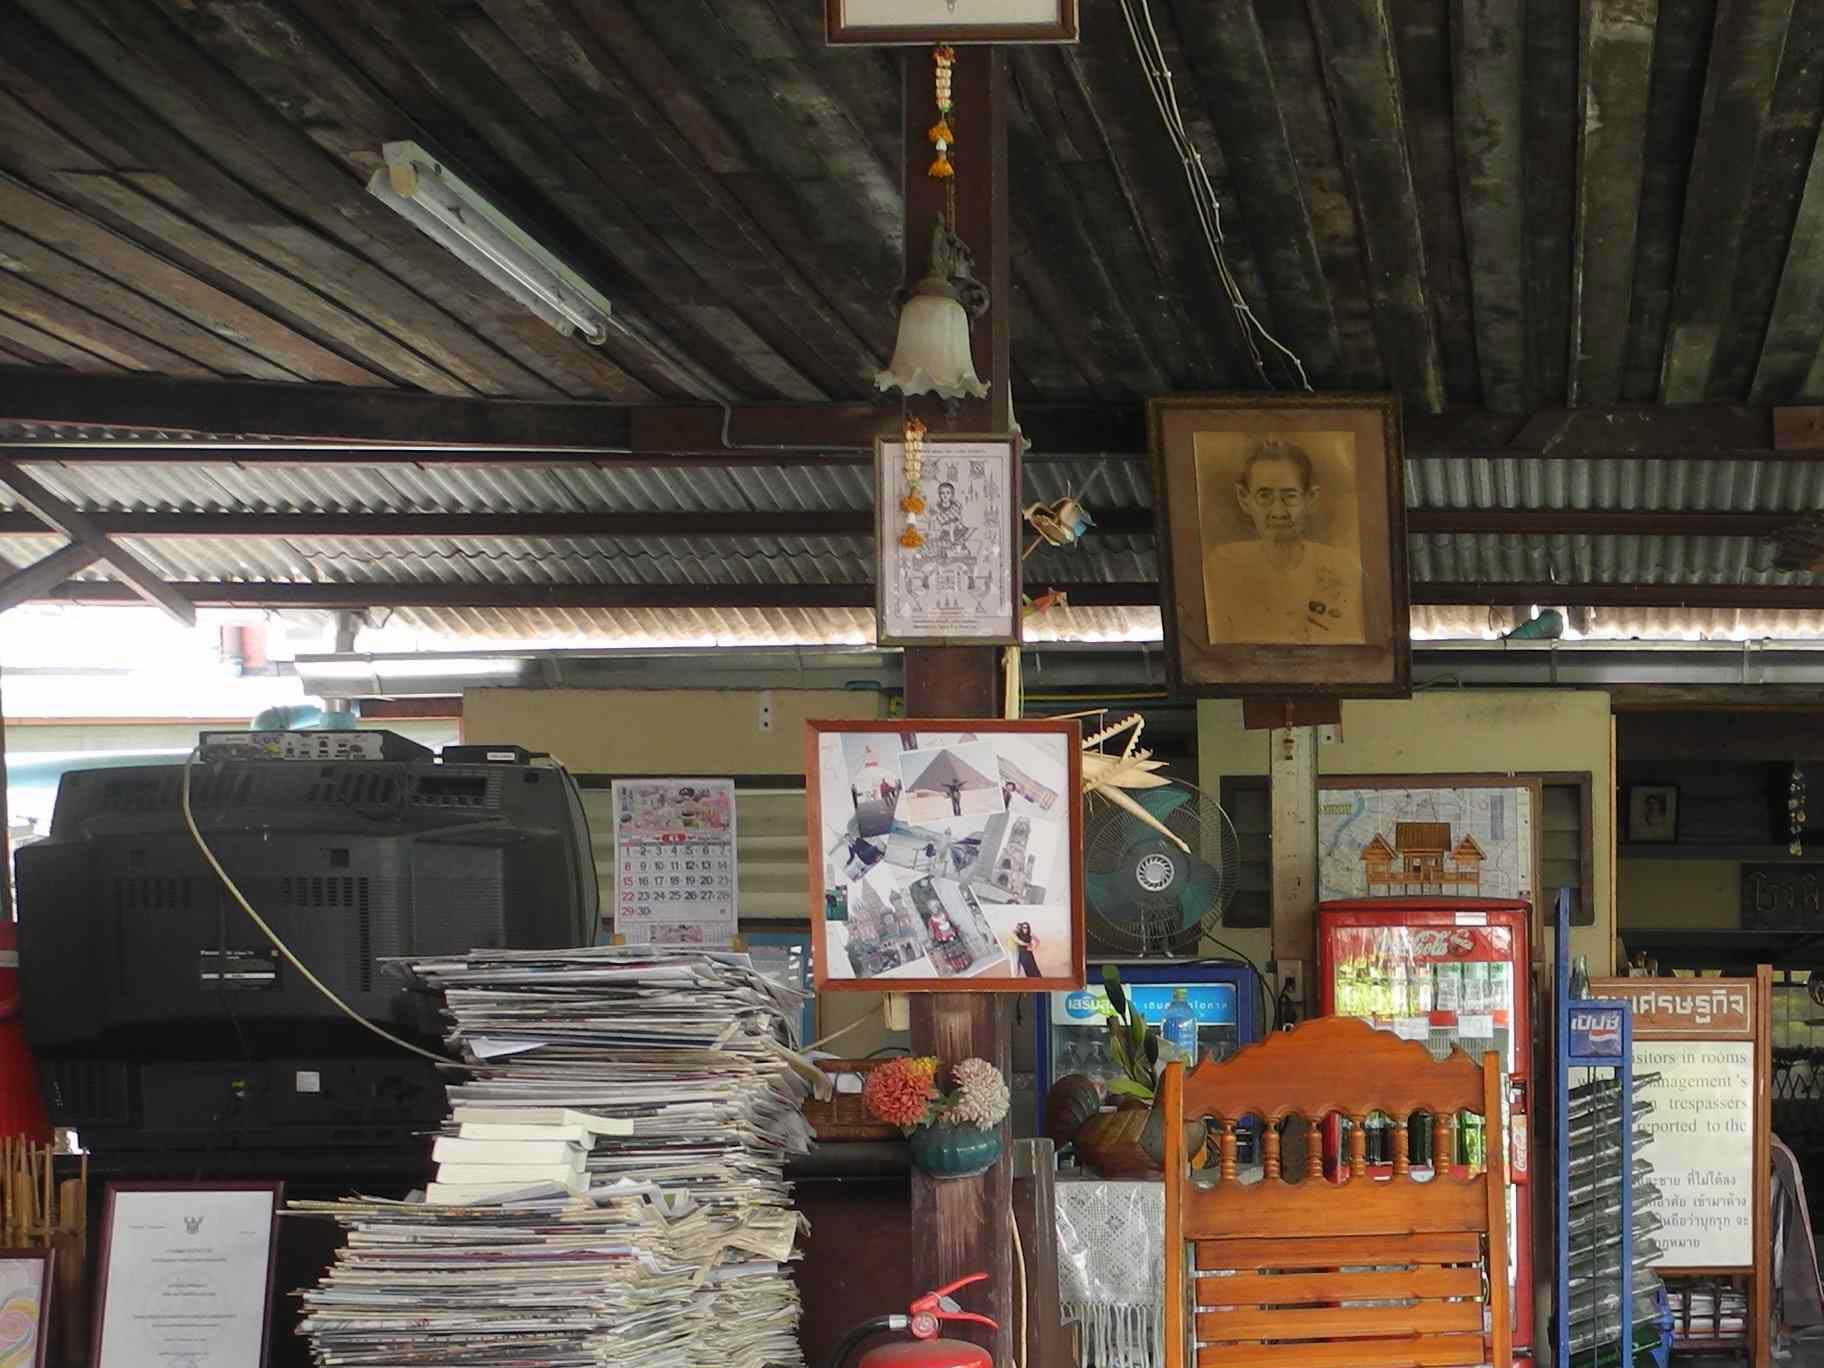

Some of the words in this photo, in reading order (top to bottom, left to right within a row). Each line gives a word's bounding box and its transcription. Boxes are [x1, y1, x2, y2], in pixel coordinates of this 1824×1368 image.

[627, 847, 632, 857] 1
[640, 846, 647, 857] 2
[656, 846, 663, 857] 3
[671, 846, 678, 856] 4
[685, 846, 694, 856] 5
[702, 846, 710, 856] 6
[625, 862, 632, 872] 8
[640, 862, 647, 872] 9
[654, 862, 665, 872] 10
[671, 861, 680, 871] 11
[685, 861, 696, 871] 12
[701, 861, 712, 871] 13
[718, 861, 728, 871] 14
[623, 877, 633, 887] 15
[638, 876, 649, 887] 16
[654, 876, 664, 886] 17
[670, 876, 680, 886] 18
[685, 876, 696, 886] 19
[700, 876, 713, 886] 20
[622, 891, 634, 901] 22
[638, 891, 650, 901] 23
[653, 891, 666, 901] 24
[669, 890, 681, 901] 25
[684, 890, 697, 901] 26
[700, 890, 713, 901] 27
[622, 906, 634, 917] 29
[638, 906, 651, 916] 30
[1582, 988, 1744, 1023] เศรษฐกิจ
[1682, 1049, 1696, 1064] in
[1701, 1054, 1747, 1064] rooms
[1650, 1077, 1731, 1091] anagement
[1669, 1098, 1747, 1112] trespassers
[1707, 1120, 1721, 1133] to
[1725, 1118, 1747, 1133] the
